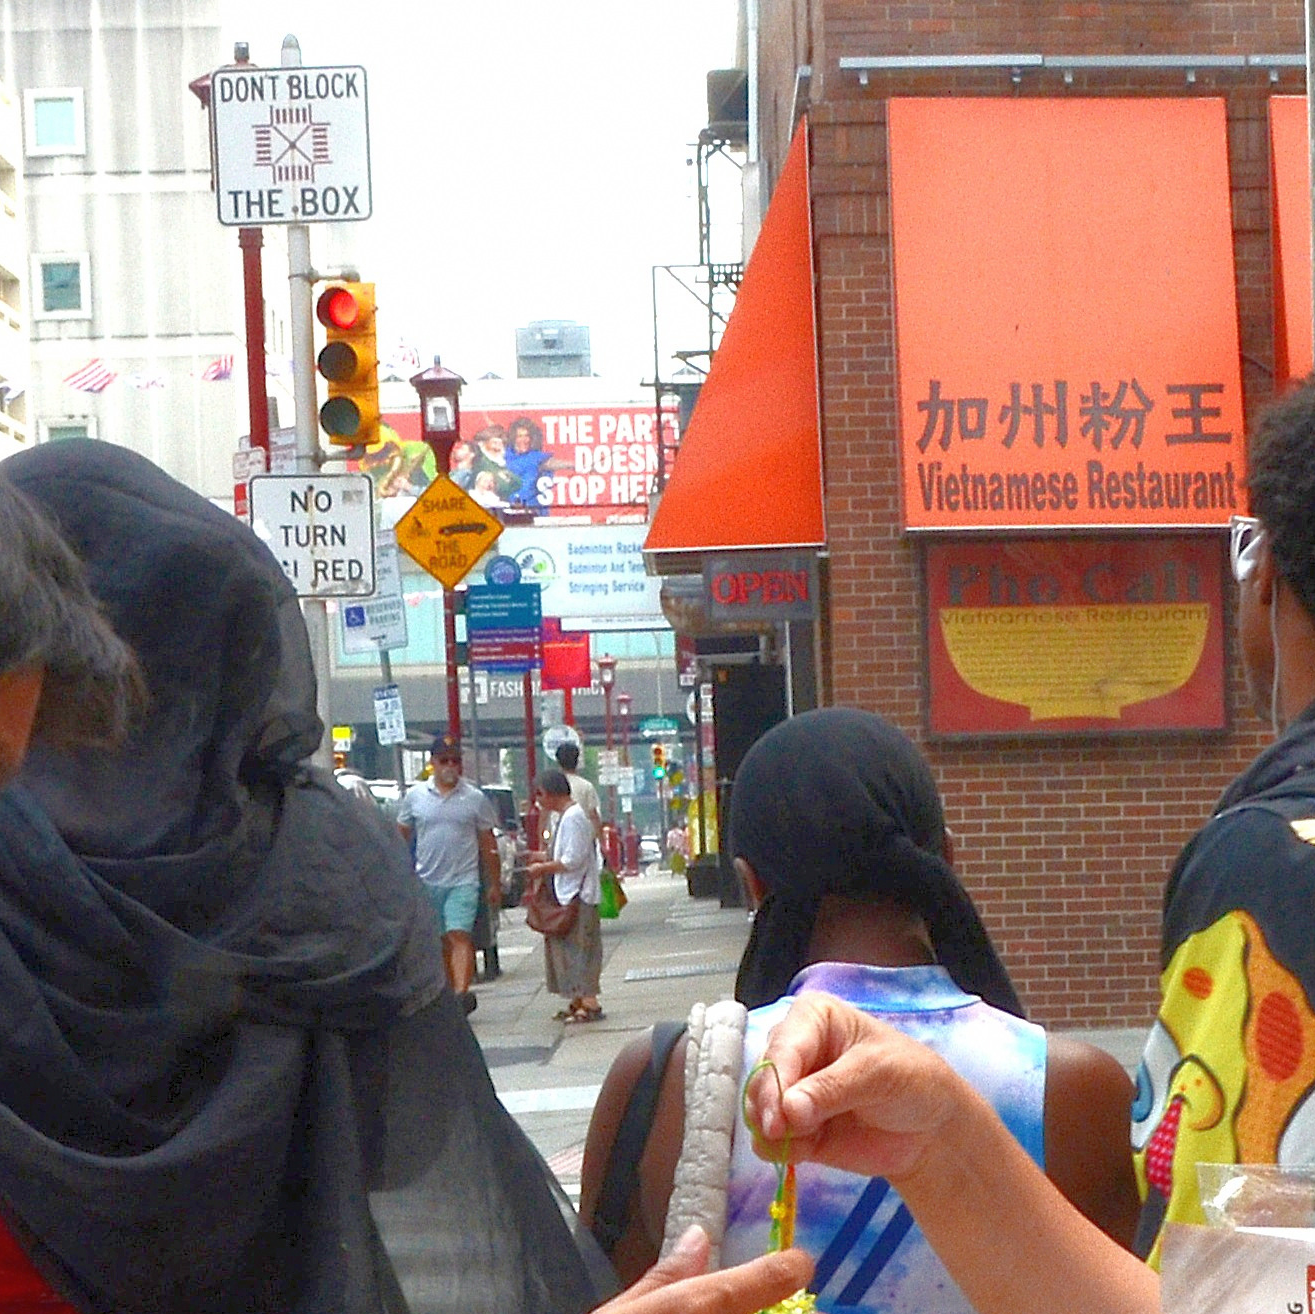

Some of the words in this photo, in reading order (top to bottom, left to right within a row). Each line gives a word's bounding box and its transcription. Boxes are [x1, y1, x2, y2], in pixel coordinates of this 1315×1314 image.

[220, 75, 279, 103] DON'T
[287, 73, 359, 100] BLOCK
[228, 189, 285, 219] THE
[300, 186, 360, 216] BOX
[541, 415, 594, 444] THE
[916, 378, 1233, 453] 加州粉王
[536, 474, 606, 506] STOP
[917, 461, 1079, 512] Vietnamese
[1086, 459, 1237, 510] Restaurant
[291, 490, 332, 513] NO
[422, 497, 466, 513] SHARE
[279, 525, 346, 547] TURN
[435, 540, 460, 554] THE
[313, 559, 363, 581] RED
[429, 554, 468, 569] ROAD
[711, 569, 809, 606] OPEN
[947, 563, 1060, 606] Pho
[1083, 560, 1200, 604] Cali
[942, 608, 1075, 626] Vietnamese
[1087, 606, 1210, 624] Restaurant
